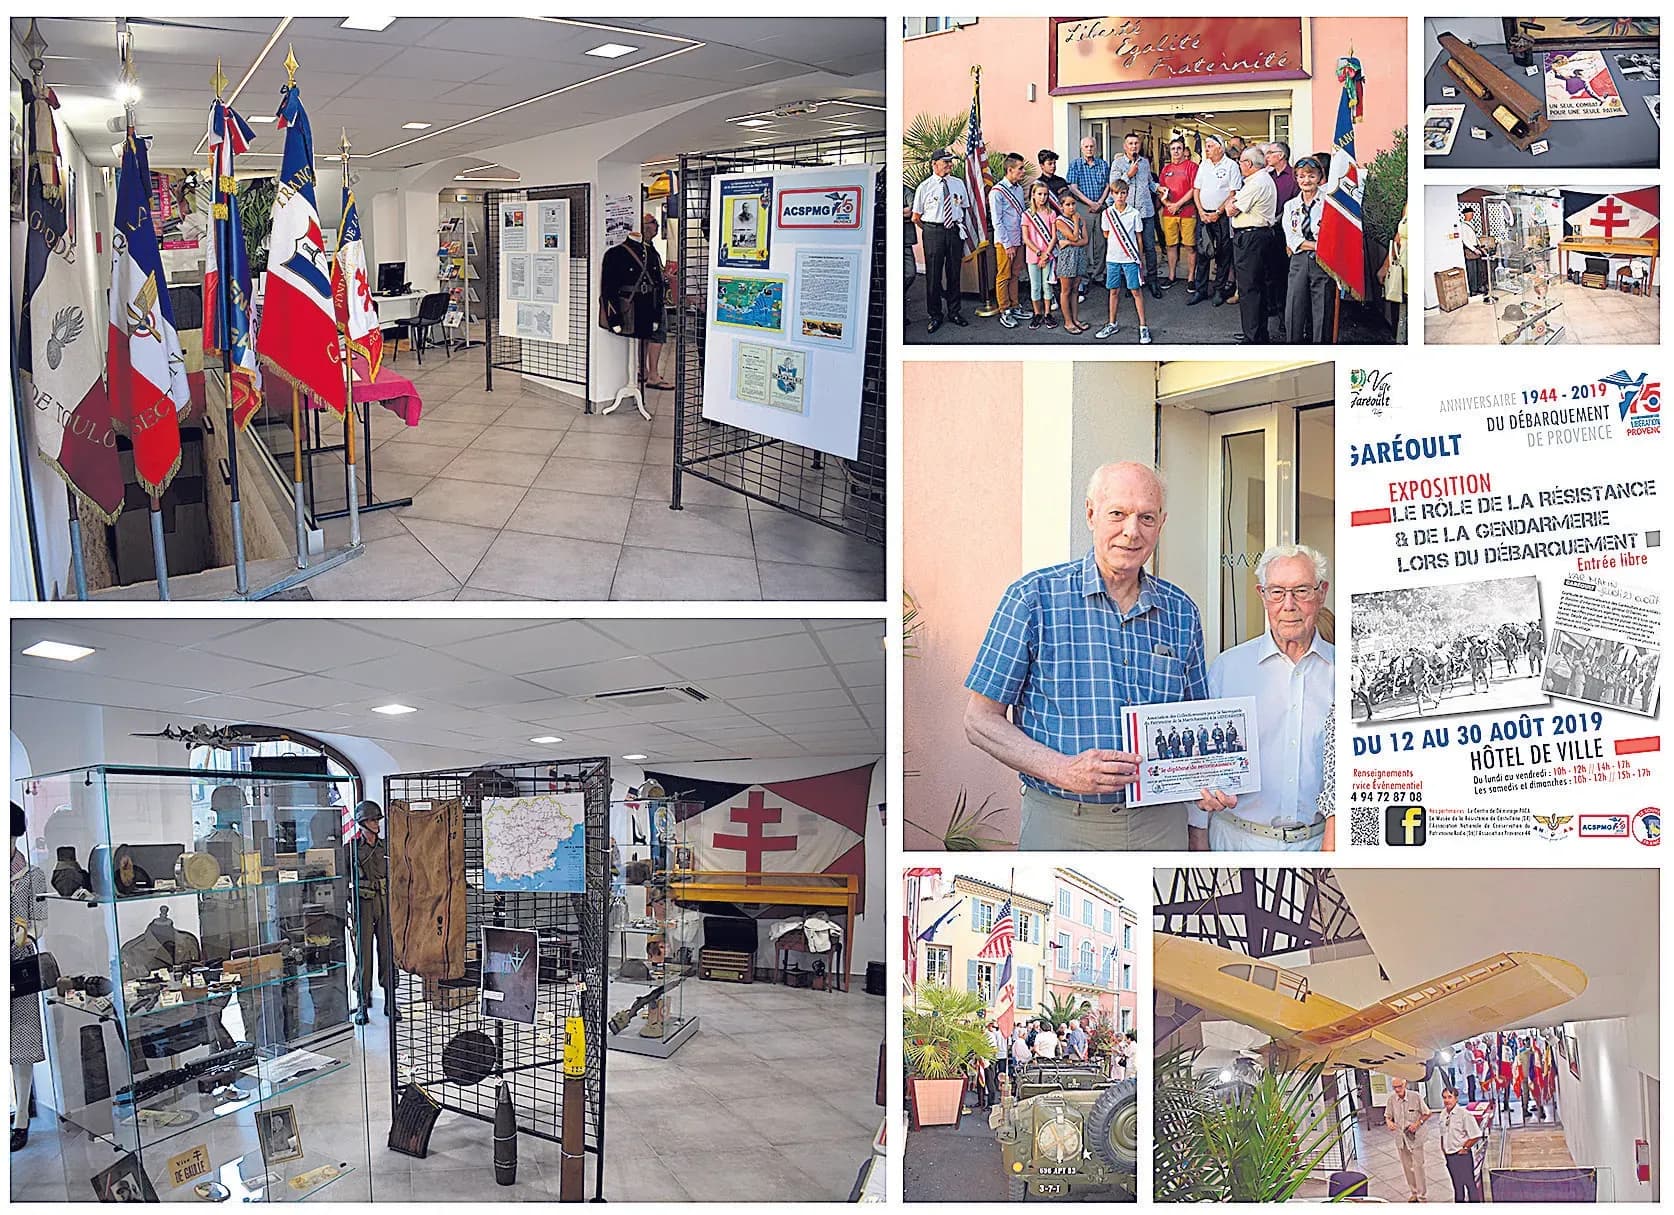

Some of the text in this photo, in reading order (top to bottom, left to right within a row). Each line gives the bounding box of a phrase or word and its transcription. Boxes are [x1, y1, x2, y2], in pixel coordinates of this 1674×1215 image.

[1065, 20, 1142, 43] Liberté
[1149, 51, 1289, 78] Fraternité
[783, 205, 832, 217] ACSPMG
[1439, 392, 1517, 413] ANNIVERSAIRE
[1521, 388, 1558, 405] 1944
[1571, 382, 1607, 400] 2019
[1487, 404, 1610, 432] DU DÉBARQUEMENT
[1527, 424, 1613, 448] DE PROVENCE
[1389, 472, 1492, 502] EXPOSITION
[1392, 480, 1657, 522] LE RÔLE DE LA RÉSISTANCE
[1395, 510, 1610, 547] & DE LA GENDARMERIE
[1397, 532, 1638, 573] LORS DU DÉBARQUEMENT
[1577, 551, 1648, 572] Entrée libre
[1352, 711, 1603, 756] DU 12 AU 30 AOÛT 2019
[1470, 738, 1604, 771] HÔTEL DE VILLE
[1353, 768, 1414, 780] Renseignements
[1473, 775, 1482, 784] Du
[1484, 773, 1503, 783] lundi
[1515, 769, 1547, 780] vendredi
[1553, 767, 1567, 776] 10h
[1573, 765, 1587, 774] 12h
[1597, 762, 1611, 771] 14h
[1617, 760, 1631, 769] 17h
[1474, 786, 1487, 795] Les
[1489, 782, 1519, 793] samedis
[1520, 781, 1528, 789] et
[1530, 778, 1568, 789] dimanches
[1573, 775, 1587, 785] 10h
[1594, 773, 1607, 782] 12h
[1617, 770, 1631, 780] 15h
[1637, 768, 1651, 777] 17h
[1360, 792, 1373, 802] 94
[1377, 792, 1390, 802] 72
[1393, 792, 1406, 802] 87
[1409, 792, 1423, 802] 08
[174, 1169, 184, 1183] DE
